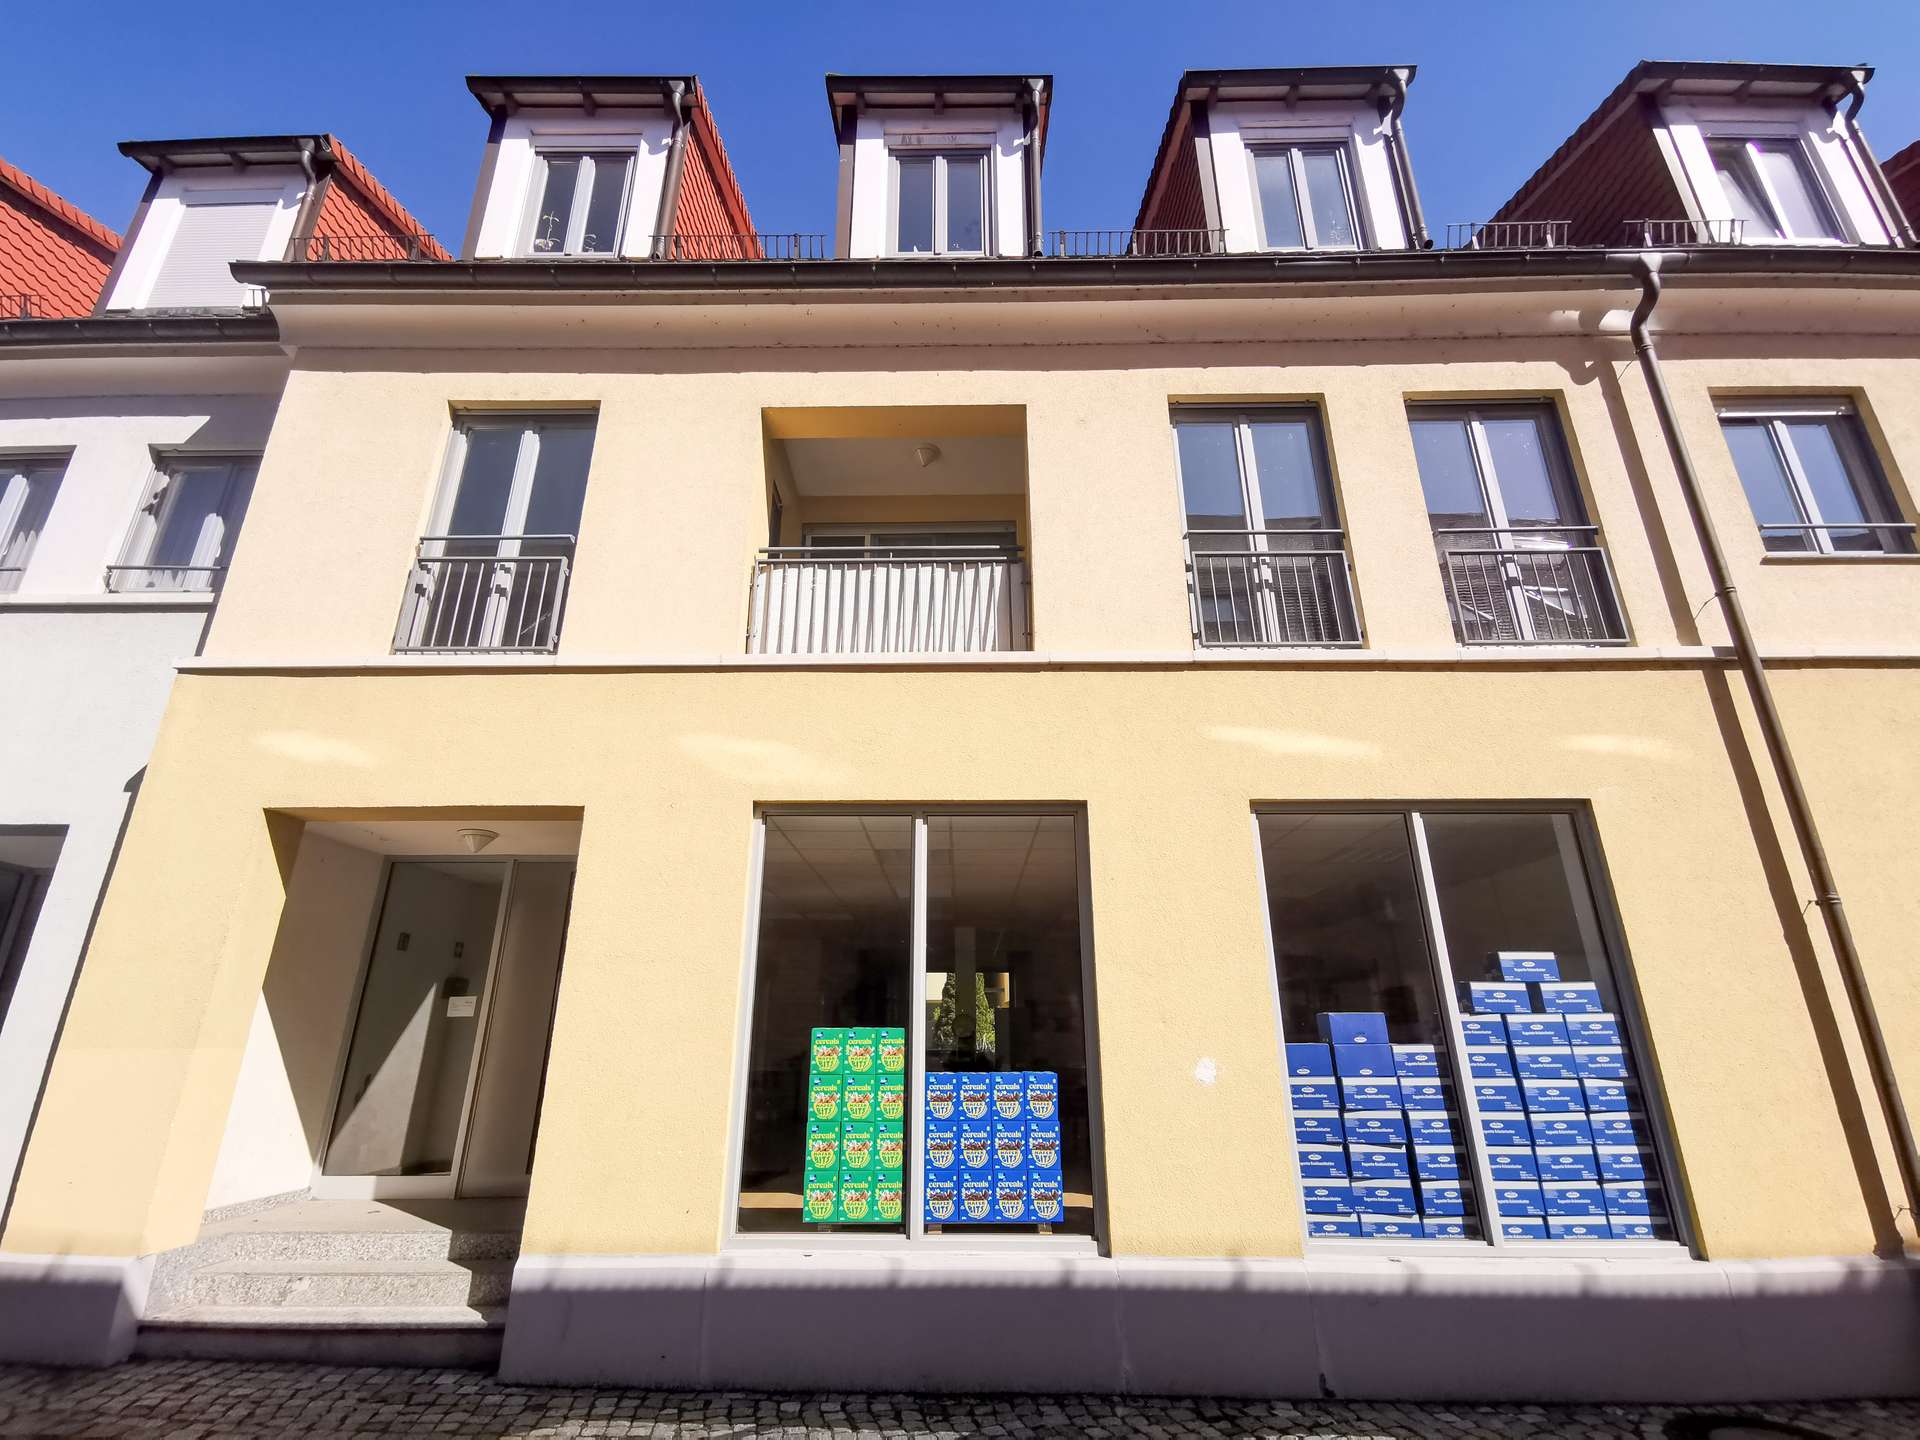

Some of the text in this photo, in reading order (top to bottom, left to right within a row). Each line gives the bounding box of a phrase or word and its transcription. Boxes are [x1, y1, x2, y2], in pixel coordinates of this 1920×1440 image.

[933, 1106, 949, 1114] BITS
[966, 1106, 982, 1114] BITS
[1000, 1106, 1016, 1114] BITS
[1034, 1106, 1049, 1114] BITS
[933, 1155, 949, 1163] BITS
[967, 1155, 983, 1163] BITS
[1001, 1155, 1017, 1163] BITS
[933, 1205, 949, 1213] BITS
[967, 1205, 983, 1213] BITS
[1002, 1205, 1018, 1213] BITS
[1037, 1205, 1053, 1213] BITS
